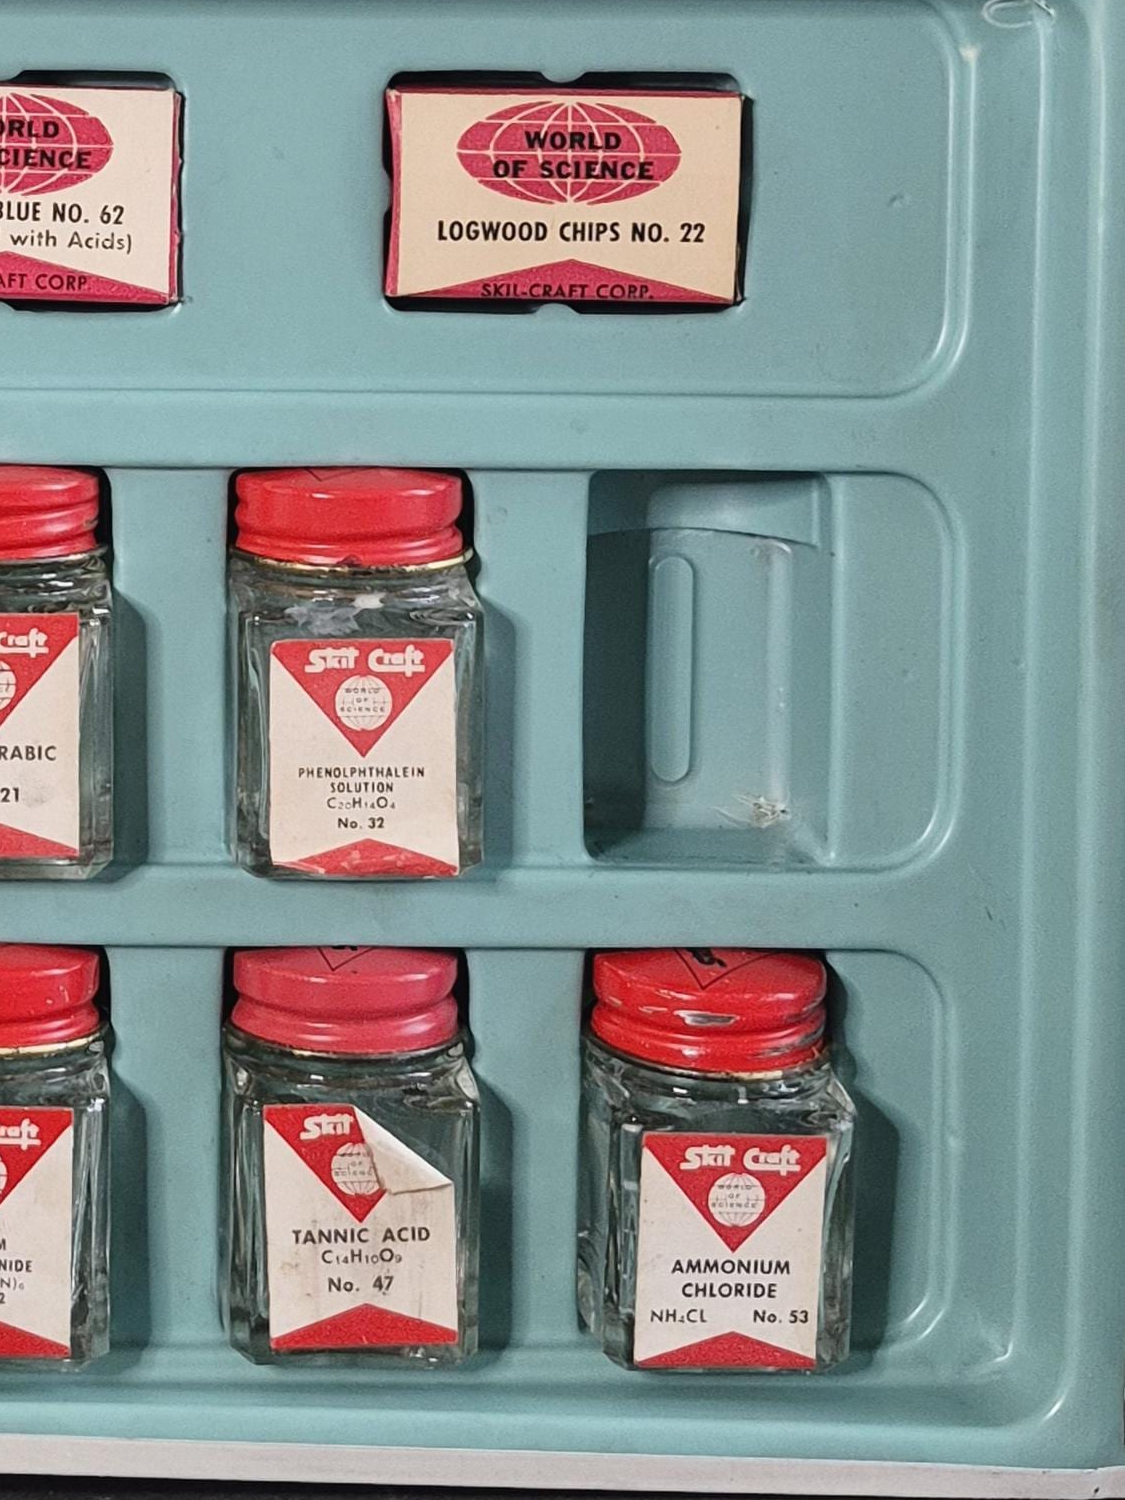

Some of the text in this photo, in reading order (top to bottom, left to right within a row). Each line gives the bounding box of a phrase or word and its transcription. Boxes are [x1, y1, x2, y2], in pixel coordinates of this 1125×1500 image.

[525, 131, 621, 151] WORLD
[492, 160, 654, 180] OF SCIENCE
[53, 203, 89, 224] NO.
[99, 204, 125, 225] 62
[437, 220, 705, 243] LOGWOOD CHIPS NO. 22
[10, 228, 58, 248] with
[68, 232, 133, 254] Acids)
[35, 273, 93, 291] CORP.
[480, 283, 654, 299] SKIL-CRAFT CORP.
[367, 644, 425, 677] Craft
[298, 766, 425, 779] PHENOLPHTHALEIN
[0, 787, 20, 803] 21
[330, 781, 394, 794] SOLUTION
[337, 816, 385, 830] No. 32
[743, 1144, 801, 1176] Craft
[292, 1226, 431, 1245] TANNIC ACID
[671, 1259, 790, 1275] AMMONIUM
[328, 1275, 394, 1293] No. 47
[682, 1283, 777, 1298] CHLORIDE
[753, 1310, 782, 1324] No.
[789, 1310, 809, 1324] 53
